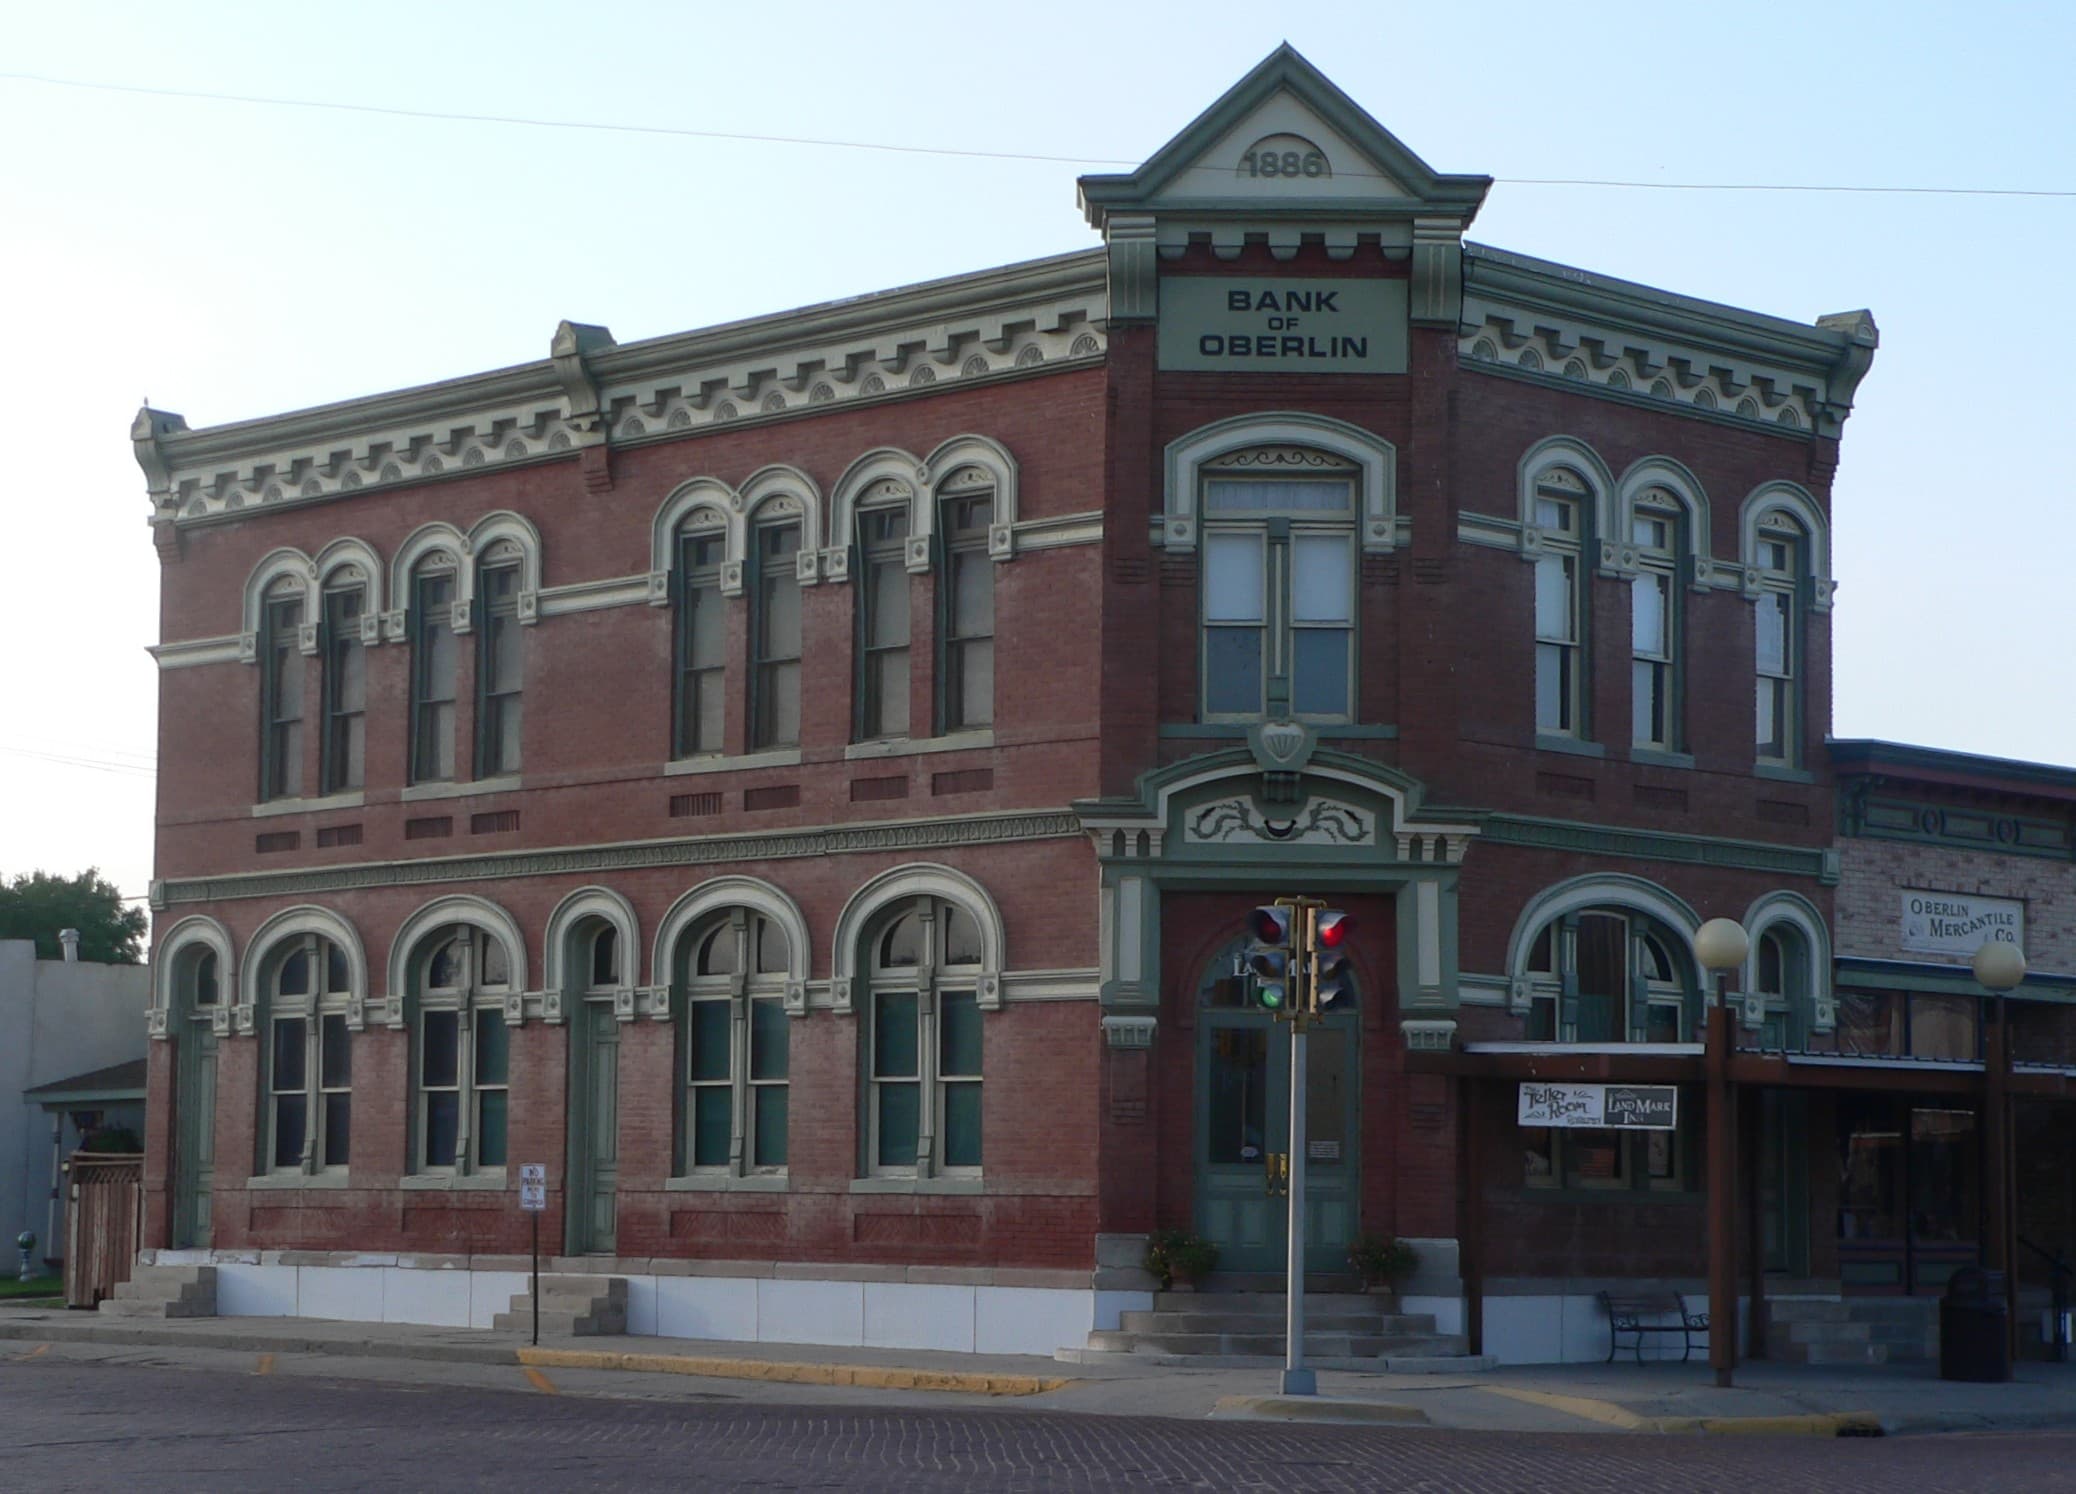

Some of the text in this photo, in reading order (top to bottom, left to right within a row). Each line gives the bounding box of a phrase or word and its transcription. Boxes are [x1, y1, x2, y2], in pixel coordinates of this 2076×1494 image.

[1244, 151, 1323, 178] 1886
[1227, 290, 1340, 313] BANK
[1267, 317, 1299, 332] OF
[1199, 335, 1368, 359] OBERLIN
[1910, 898, 1969, 917] OBERLIN
[1929, 912, 2014, 938] MERCANTILE
